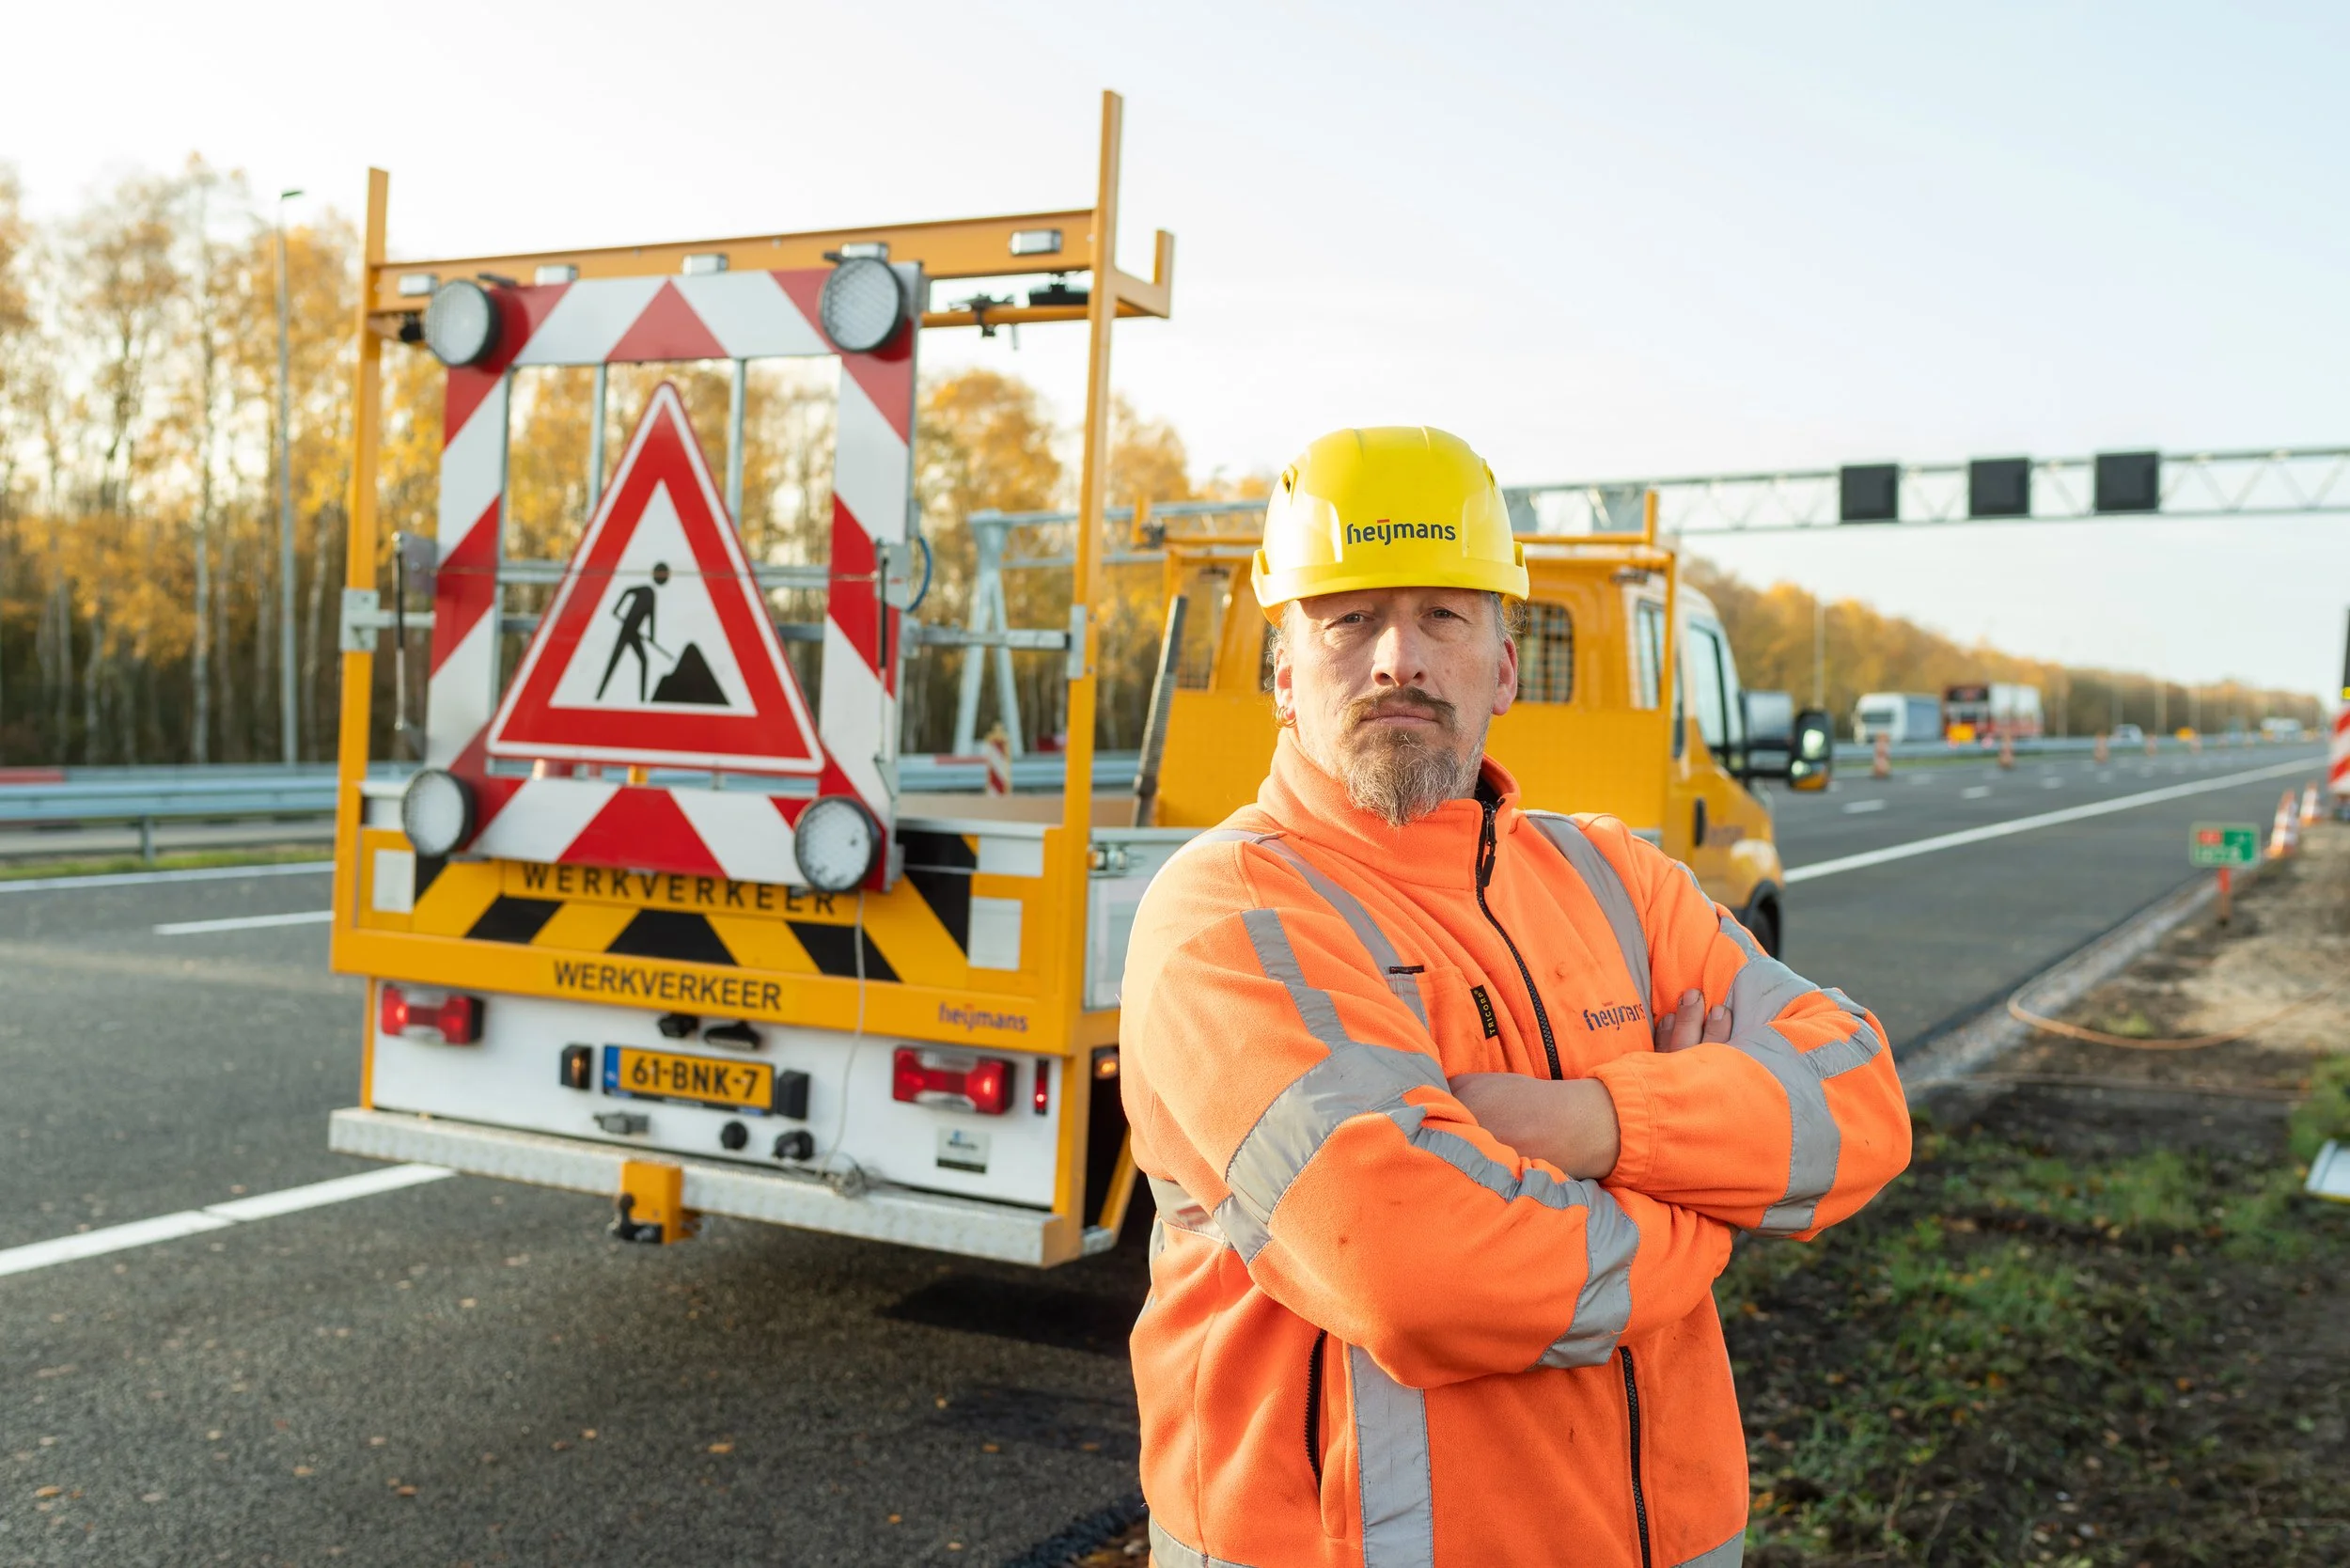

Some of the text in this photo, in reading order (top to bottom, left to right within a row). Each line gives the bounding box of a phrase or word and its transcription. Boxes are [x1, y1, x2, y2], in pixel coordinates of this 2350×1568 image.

[1346, 518, 1457, 546] heijmans
[523, 863, 837, 917] WERKVERKEER
[553, 959, 782, 1011] WERKVERKEER
[632, 1057, 760, 1099] 61-BNK-7
